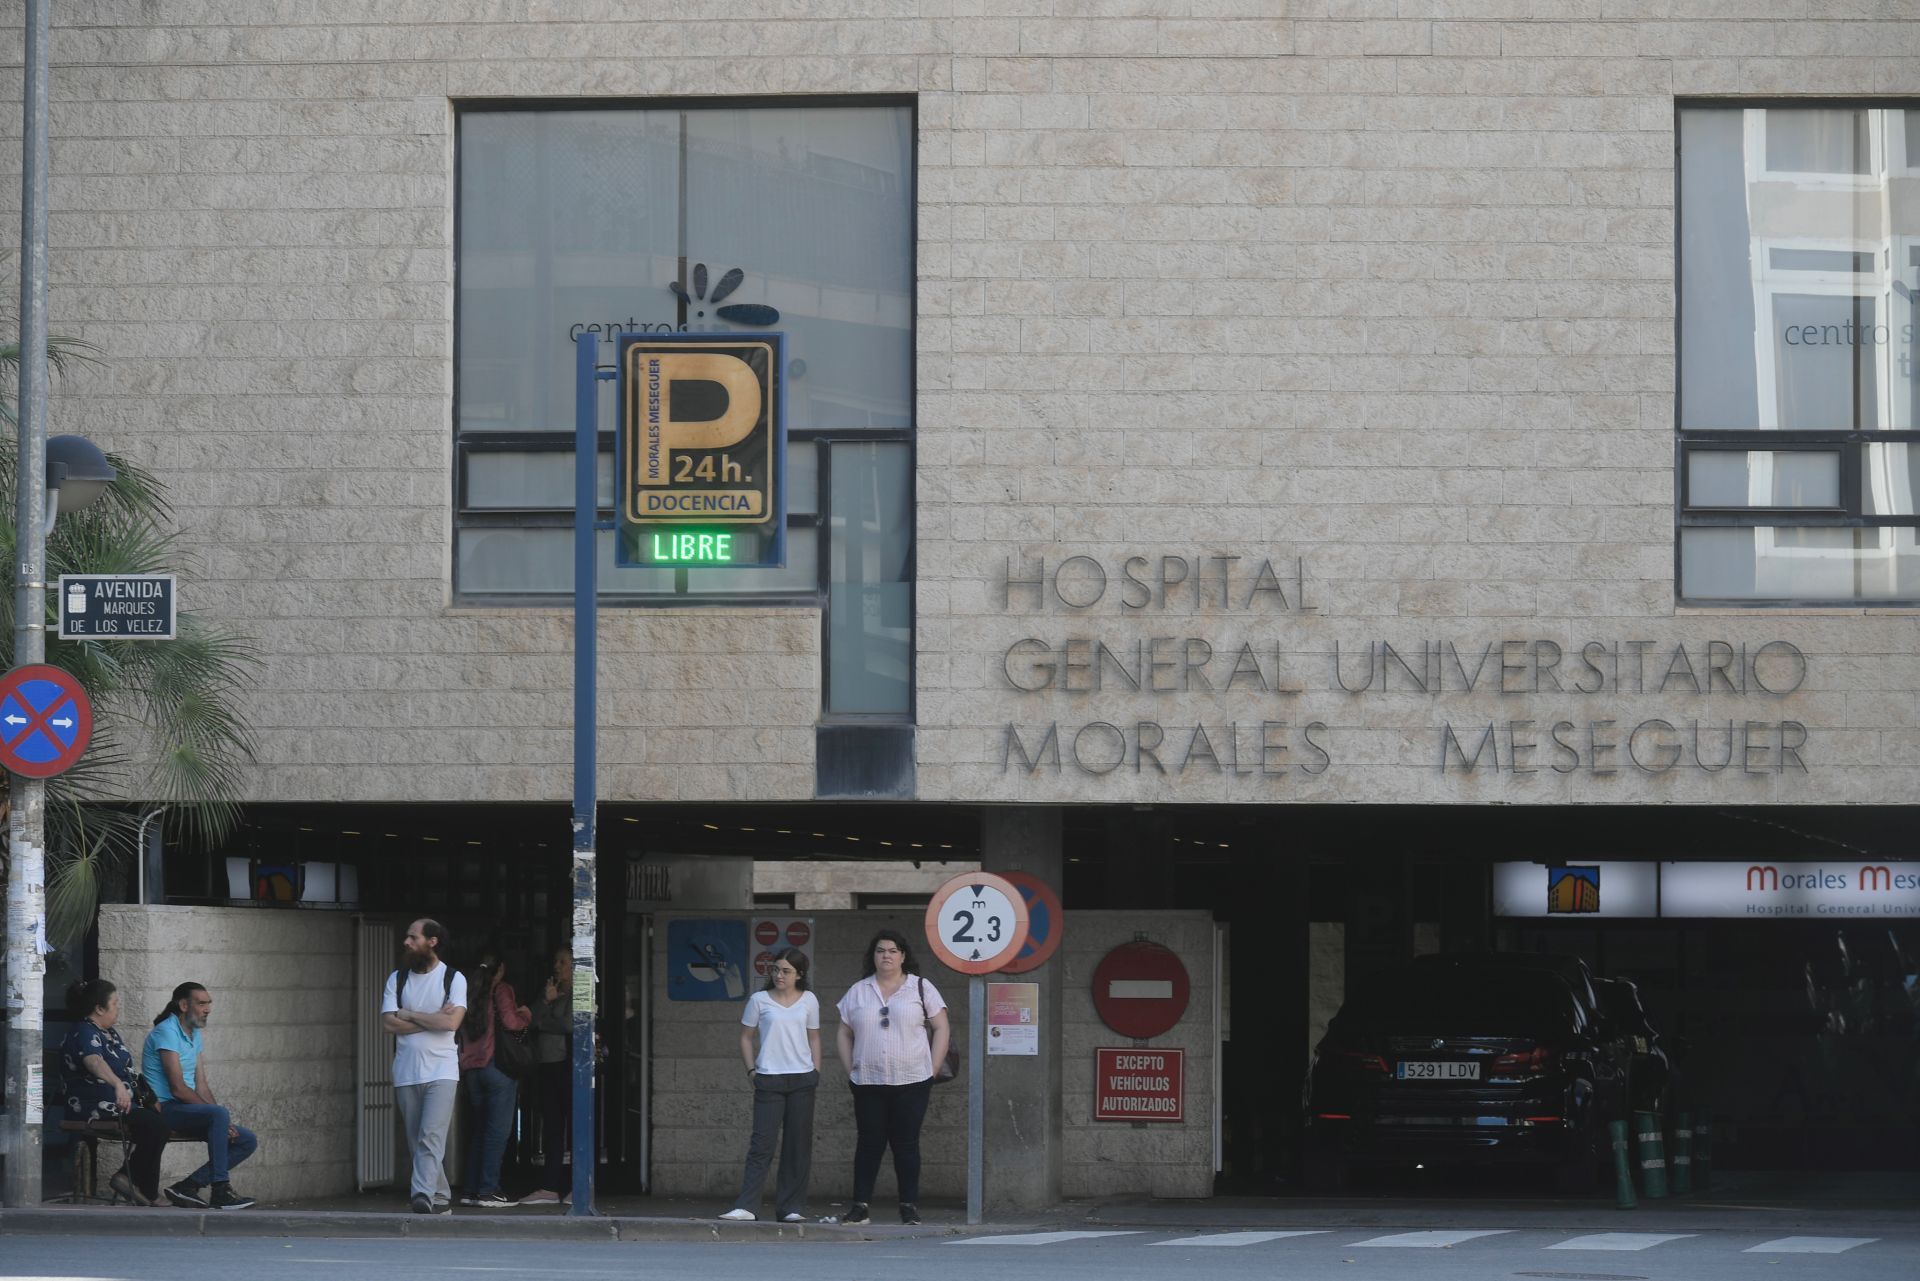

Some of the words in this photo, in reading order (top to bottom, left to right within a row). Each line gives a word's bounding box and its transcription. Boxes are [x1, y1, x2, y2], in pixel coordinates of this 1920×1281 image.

[1785, 319, 1889, 345] centro
[648, 358, 660, 424] MESEGUER
[638, 353, 762, 485] P
[648, 425, 660, 479] MORALES
[647, 495, 750, 511] DOCENCIA
[653, 533, 732, 561] LIBRE
[94, 581, 163, 598] AVENIDA
[1003, 554, 1319, 610] HOSPITAL
[103, 601, 156, 616] MARQUES
[70, 619, 87, 633] DE
[95, 619, 119, 633] LOS
[126, 619, 164, 633] VELEZ
[1003, 637, 1303, 693] GENERAL
[1334, 639, 1807, 695] UNIVERSITARIO
[1003, 719, 1331, 775] MORALES
[1441, 718, 1809, 775] MESEGUER
[972, 900, 986, 909] m
[1746, 903, 1810, 916] Hospital
[1816, 903, 1876, 914] General
[951, 910, 1001, 943] 2.3
[1115, 1055, 1165, 1071] EXCEPTO
[1407, 1063, 1443, 1078] 5291
[1448, 1063, 1477, 1078] LDV
[1109, 1072, 1170, 1092] VEHÍCULOS
[1102, 1096, 1177, 1113] AUTORIZADOS
